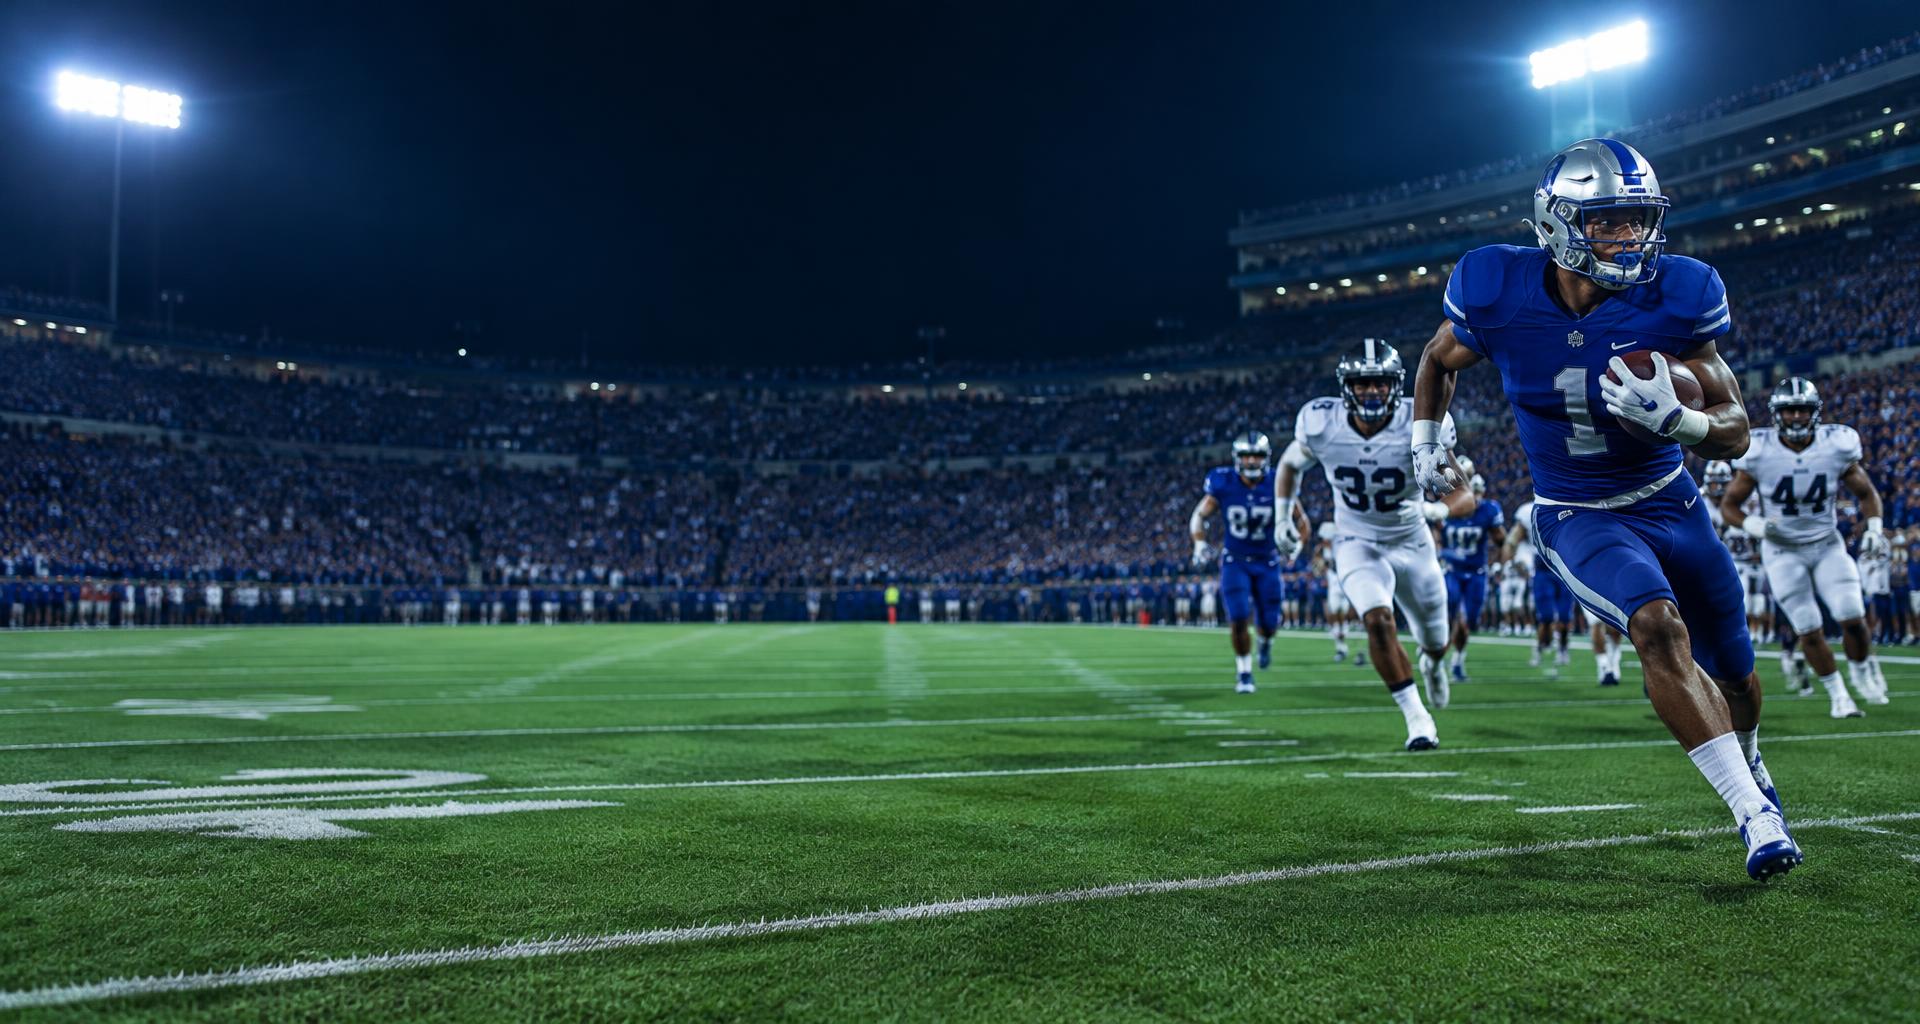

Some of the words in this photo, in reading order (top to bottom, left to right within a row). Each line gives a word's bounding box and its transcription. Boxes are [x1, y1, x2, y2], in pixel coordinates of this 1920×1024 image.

[1554, 366, 1608, 456] 1
[1334, 466, 1405, 513] 32
[1770, 473, 1827, 516] 44
[1227, 504, 1273, 540] 87
